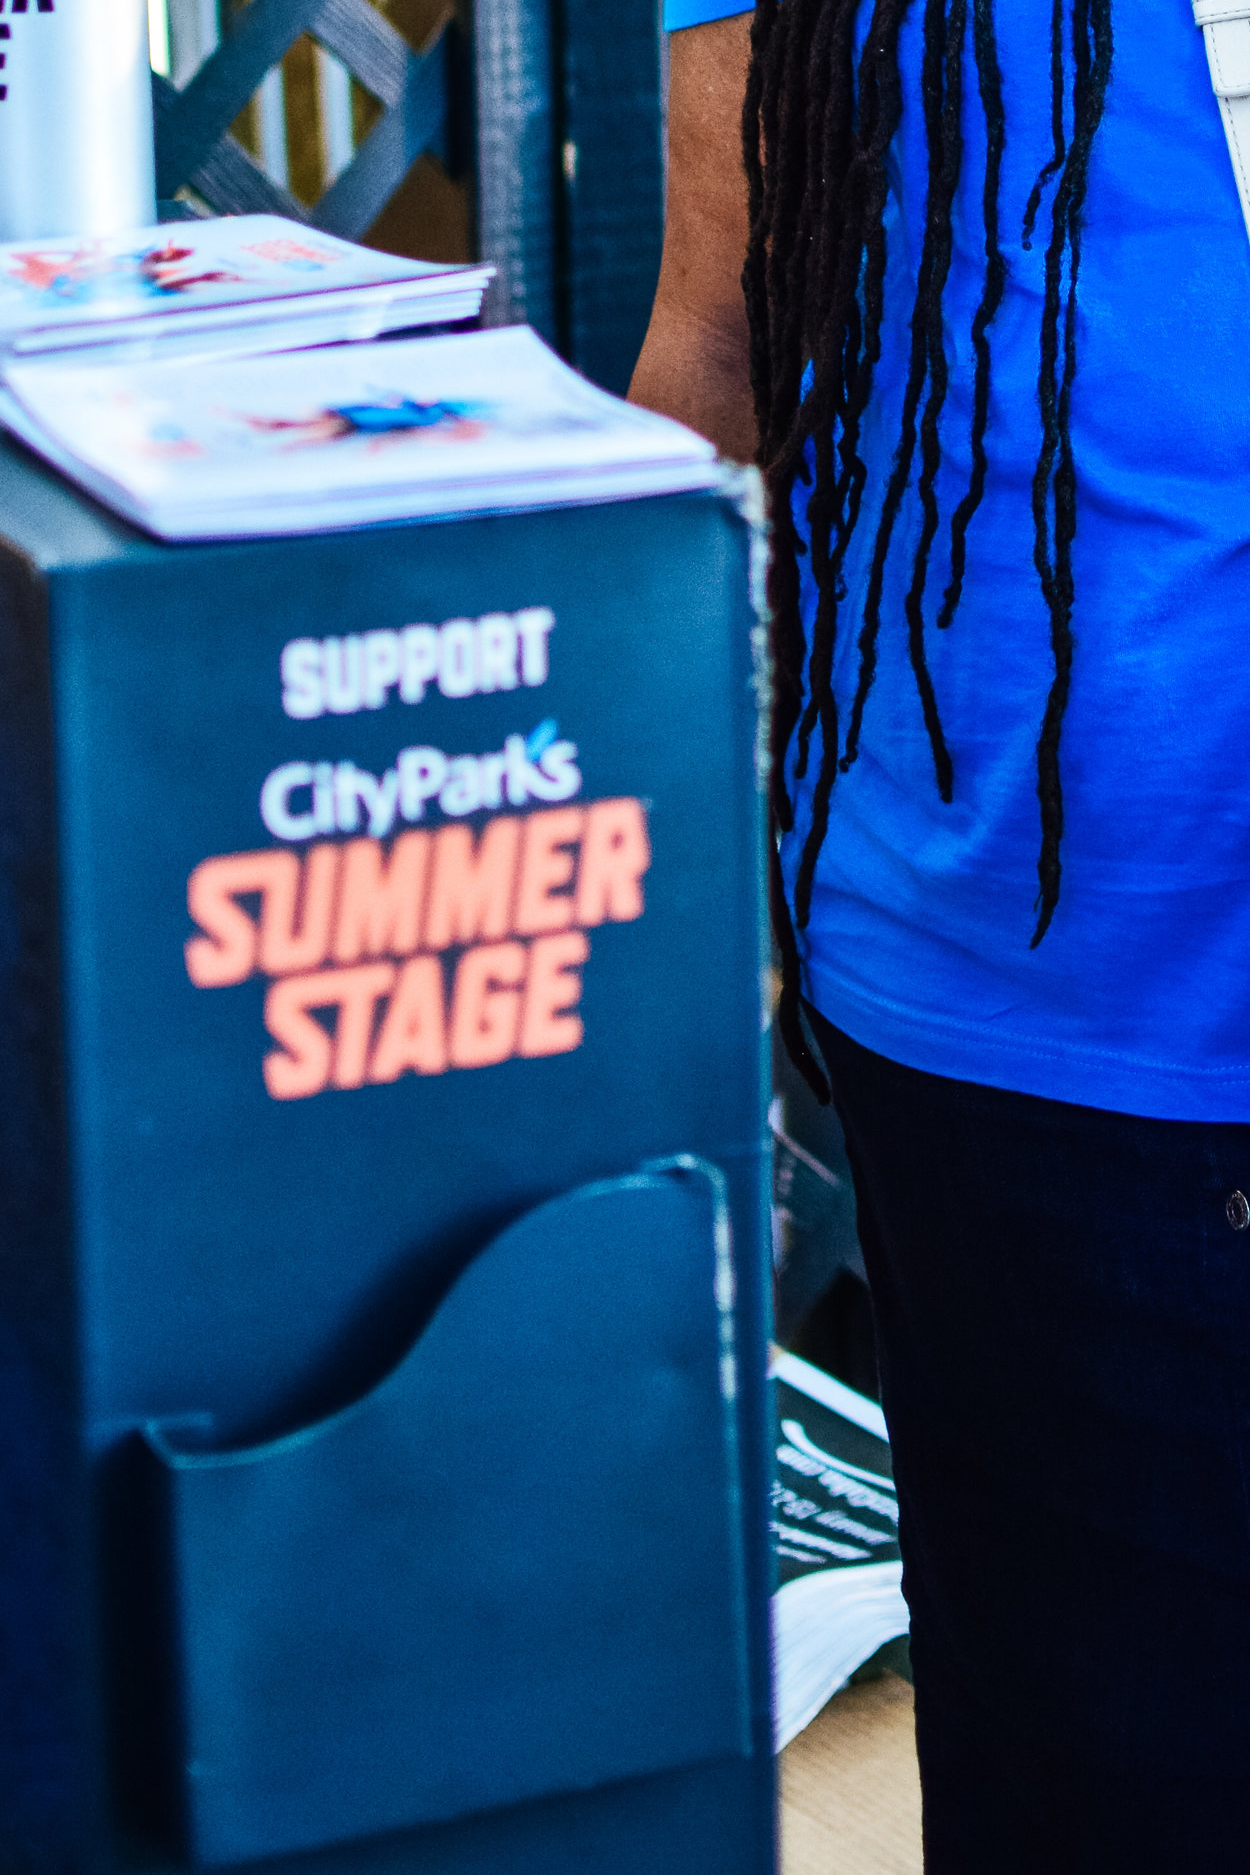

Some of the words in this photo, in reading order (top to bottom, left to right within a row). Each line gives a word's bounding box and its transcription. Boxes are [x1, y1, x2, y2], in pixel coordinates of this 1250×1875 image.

[280, 606, 555, 720] SUPPORT
[260, 719, 582, 840] CityParks
[184, 796, 651, 989] SUMMER
[263, 930, 591, 1101] STAGE
